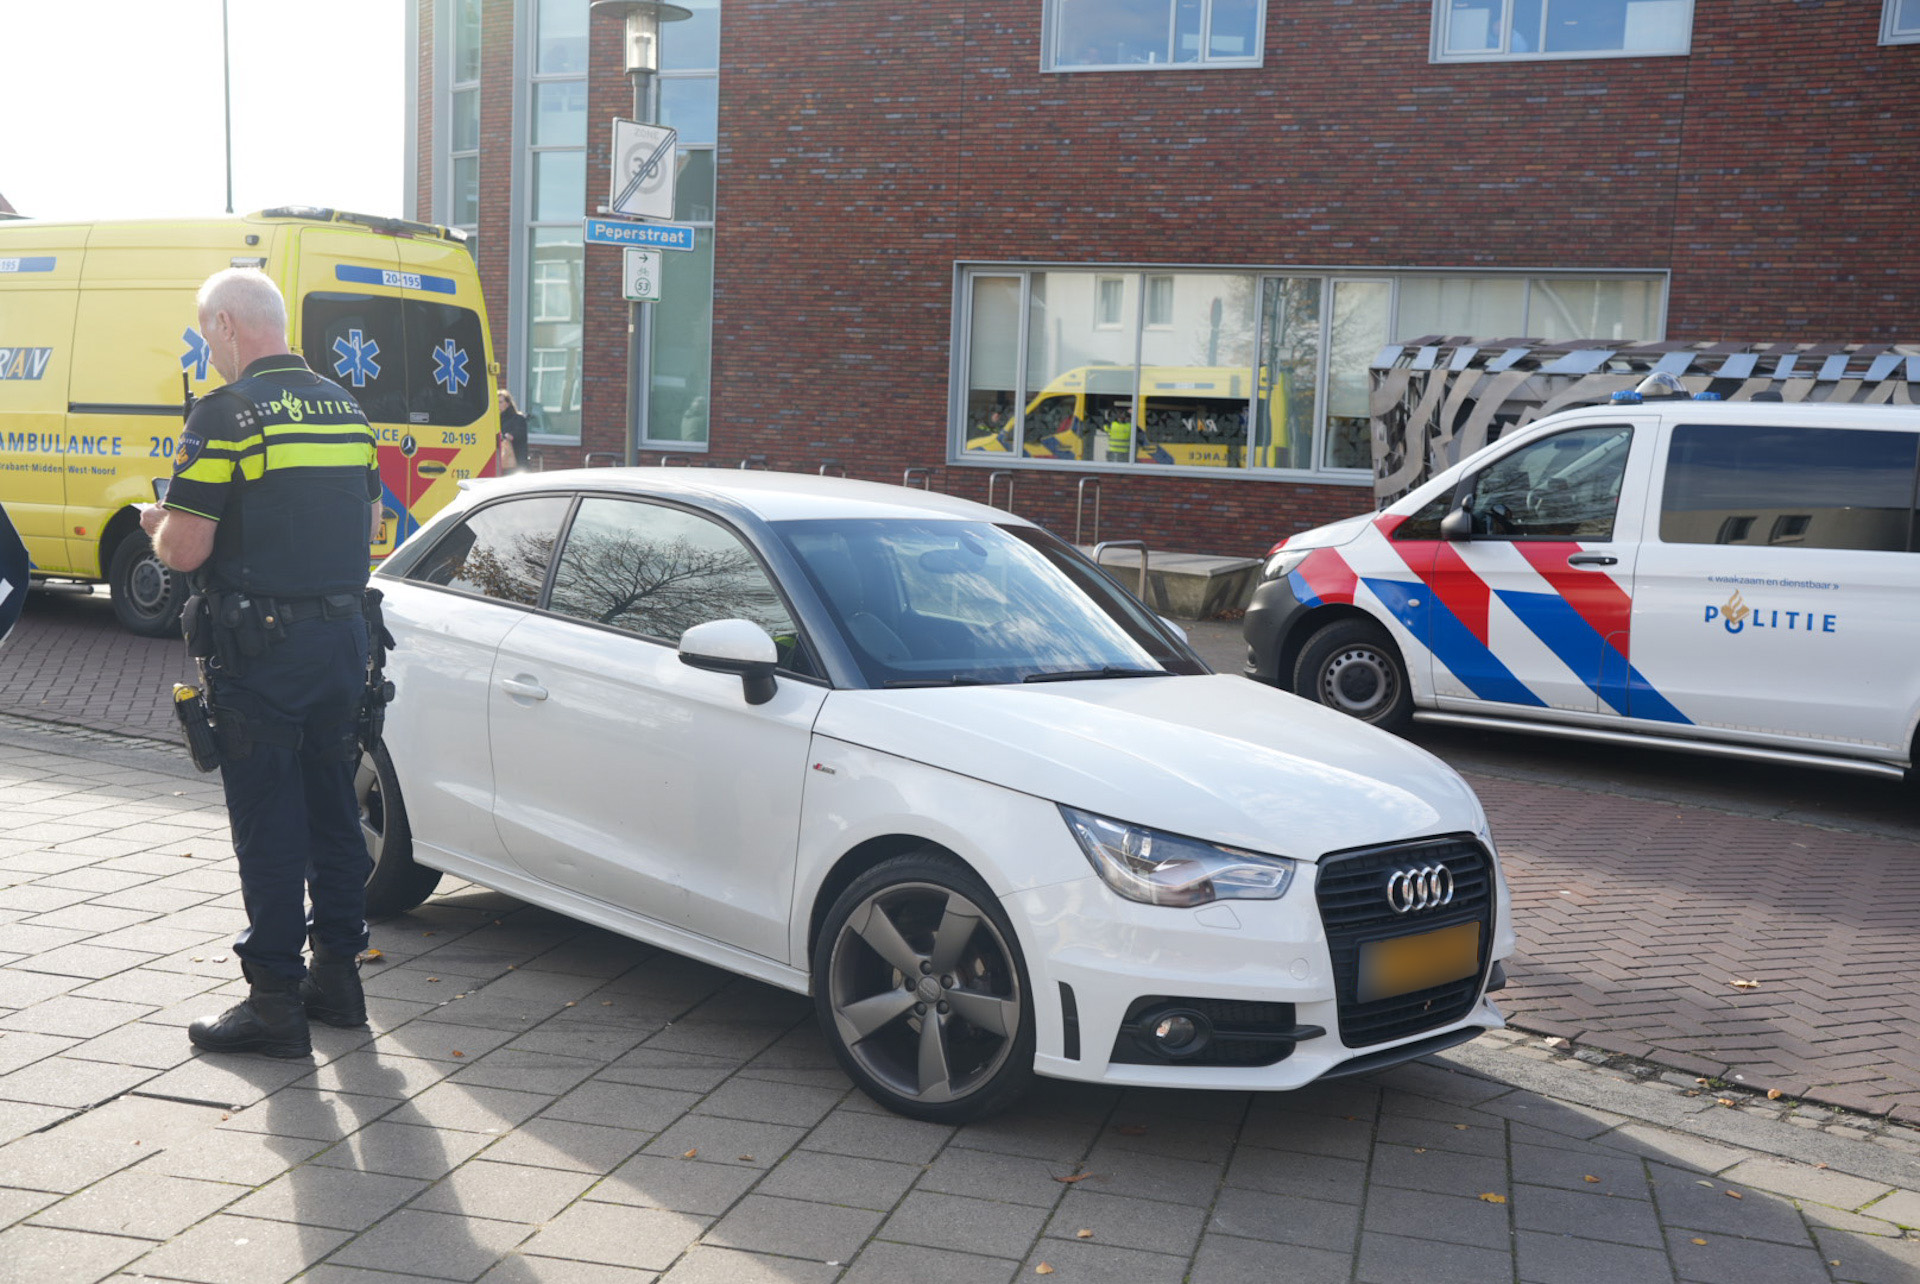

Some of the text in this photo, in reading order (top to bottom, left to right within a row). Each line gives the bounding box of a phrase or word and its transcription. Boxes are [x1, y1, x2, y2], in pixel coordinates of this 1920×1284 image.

[631, 156, 660, 180] 30
[595, 224, 685, 244] Peperstraat
[385, 272, 421, 288] 20-195
[637, 282, 650, 291] 53
[269, 400, 353, 421] POLITIE
[441, 431, 477, 445] 20-195
[456, 469, 470, 478] 112
[1704, 605, 1837, 634] POLITIE
